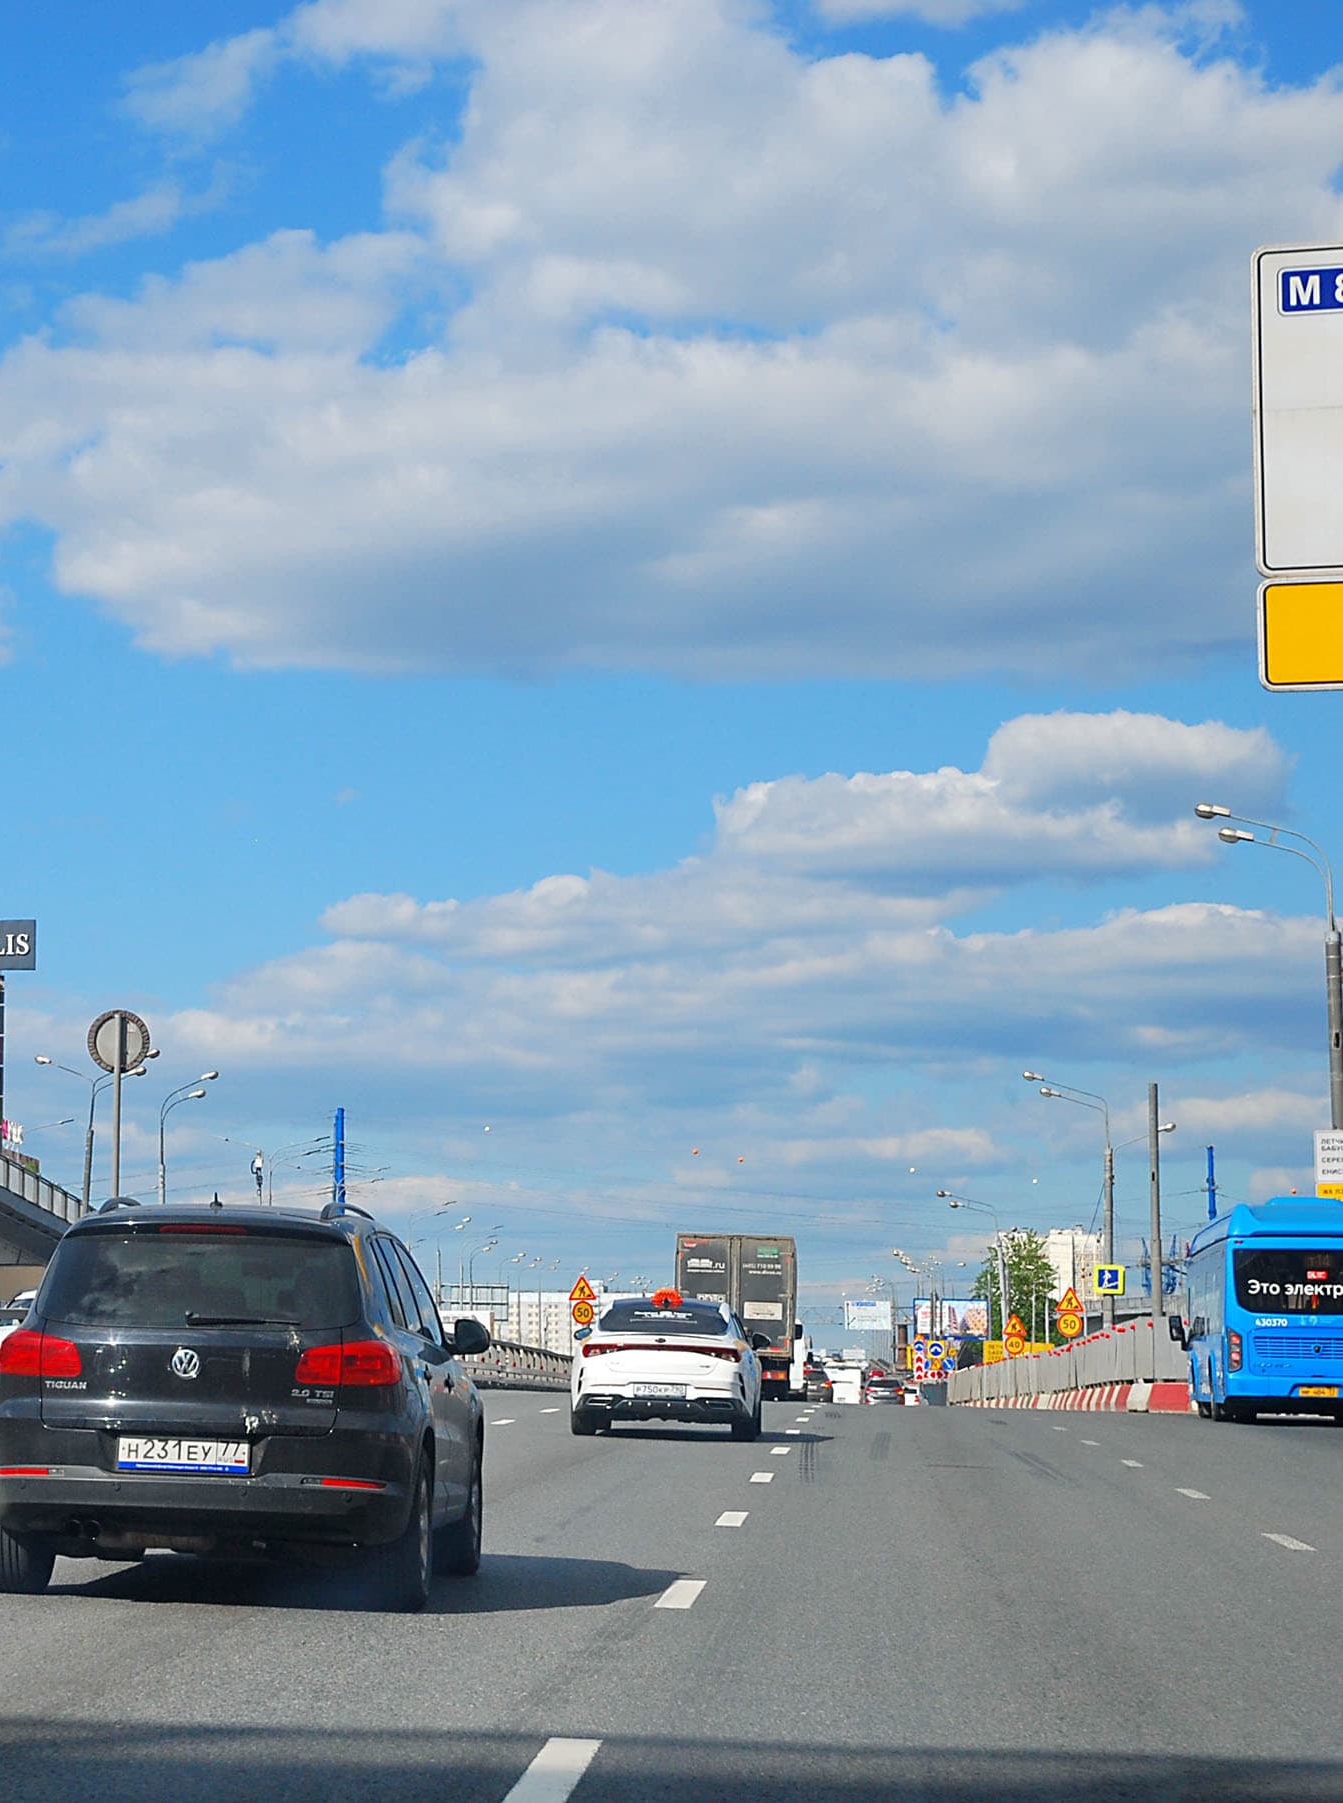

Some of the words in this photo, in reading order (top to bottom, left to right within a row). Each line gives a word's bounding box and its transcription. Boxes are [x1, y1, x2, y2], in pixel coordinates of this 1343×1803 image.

[1247, 1279, 1281, 1295] Это
[1284, 1283, 1343, 1299] электр
[577, 1307, 590, 1318] 50
[1063, 1319, 1076, 1329] 50
[1255, 1318, 1288, 1327] 430370
[44, 1380, 87, 1389] TIGUAN
